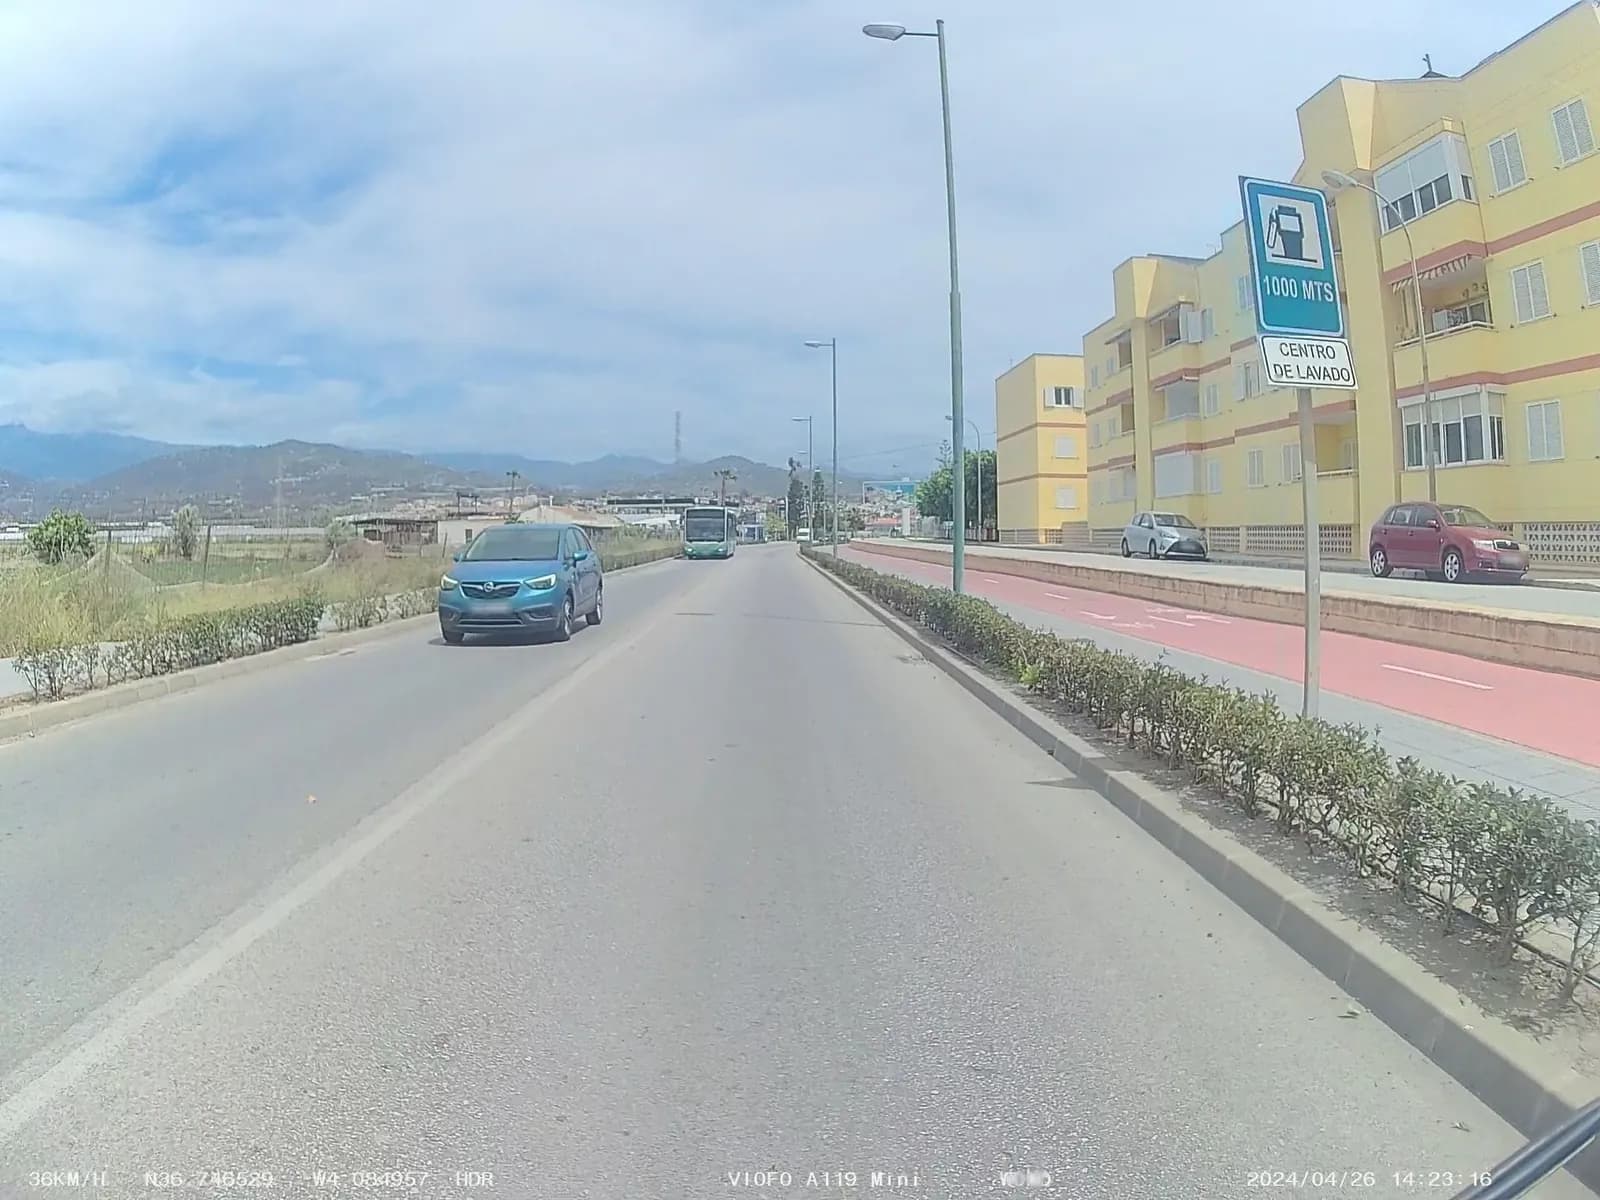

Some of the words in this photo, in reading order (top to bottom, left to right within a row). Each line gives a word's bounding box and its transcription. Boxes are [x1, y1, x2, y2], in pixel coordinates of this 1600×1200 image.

[1263, 275, 1298, 298] 1000
[1302, 280, 1334, 302] MTS
[1279, 342, 1336, 360] CENTRO
[1273, 363, 1294, 379] DE
[1296, 364, 1351, 382] LAVADO
